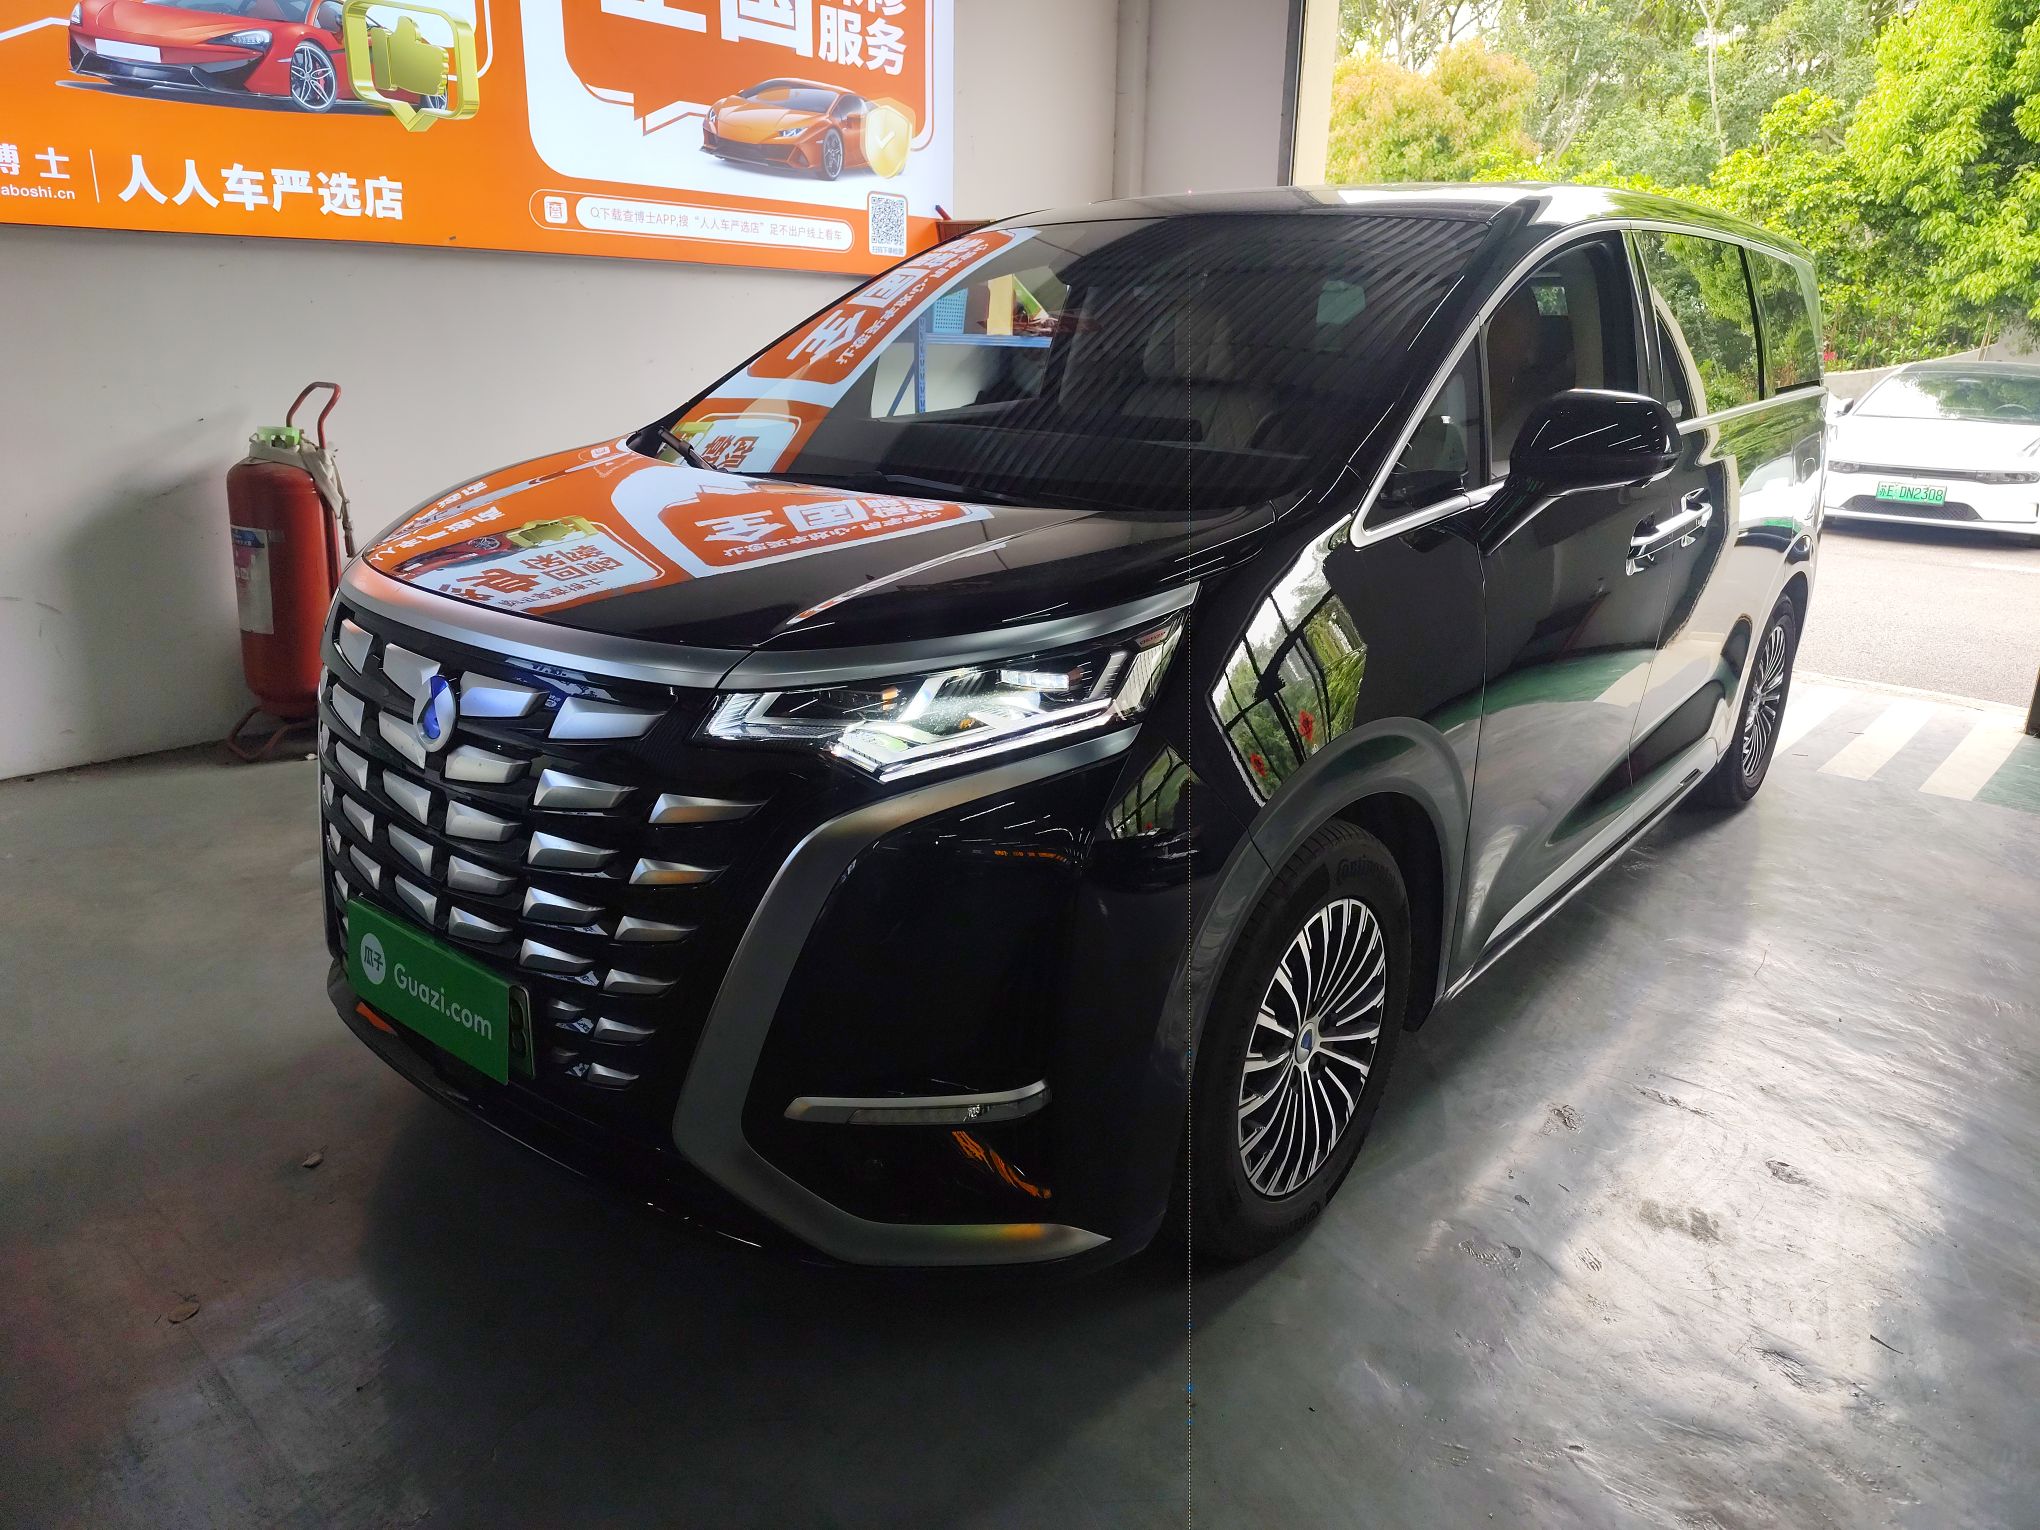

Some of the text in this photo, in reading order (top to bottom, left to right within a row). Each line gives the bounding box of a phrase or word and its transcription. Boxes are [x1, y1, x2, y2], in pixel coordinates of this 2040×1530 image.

[818, 5, 907, 75] 服务
[118, 154, 403, 220] 人人车严选店
[363, 945, 384, 973] 瓜子
[393, 963, 492, 1040] Guazi.com
